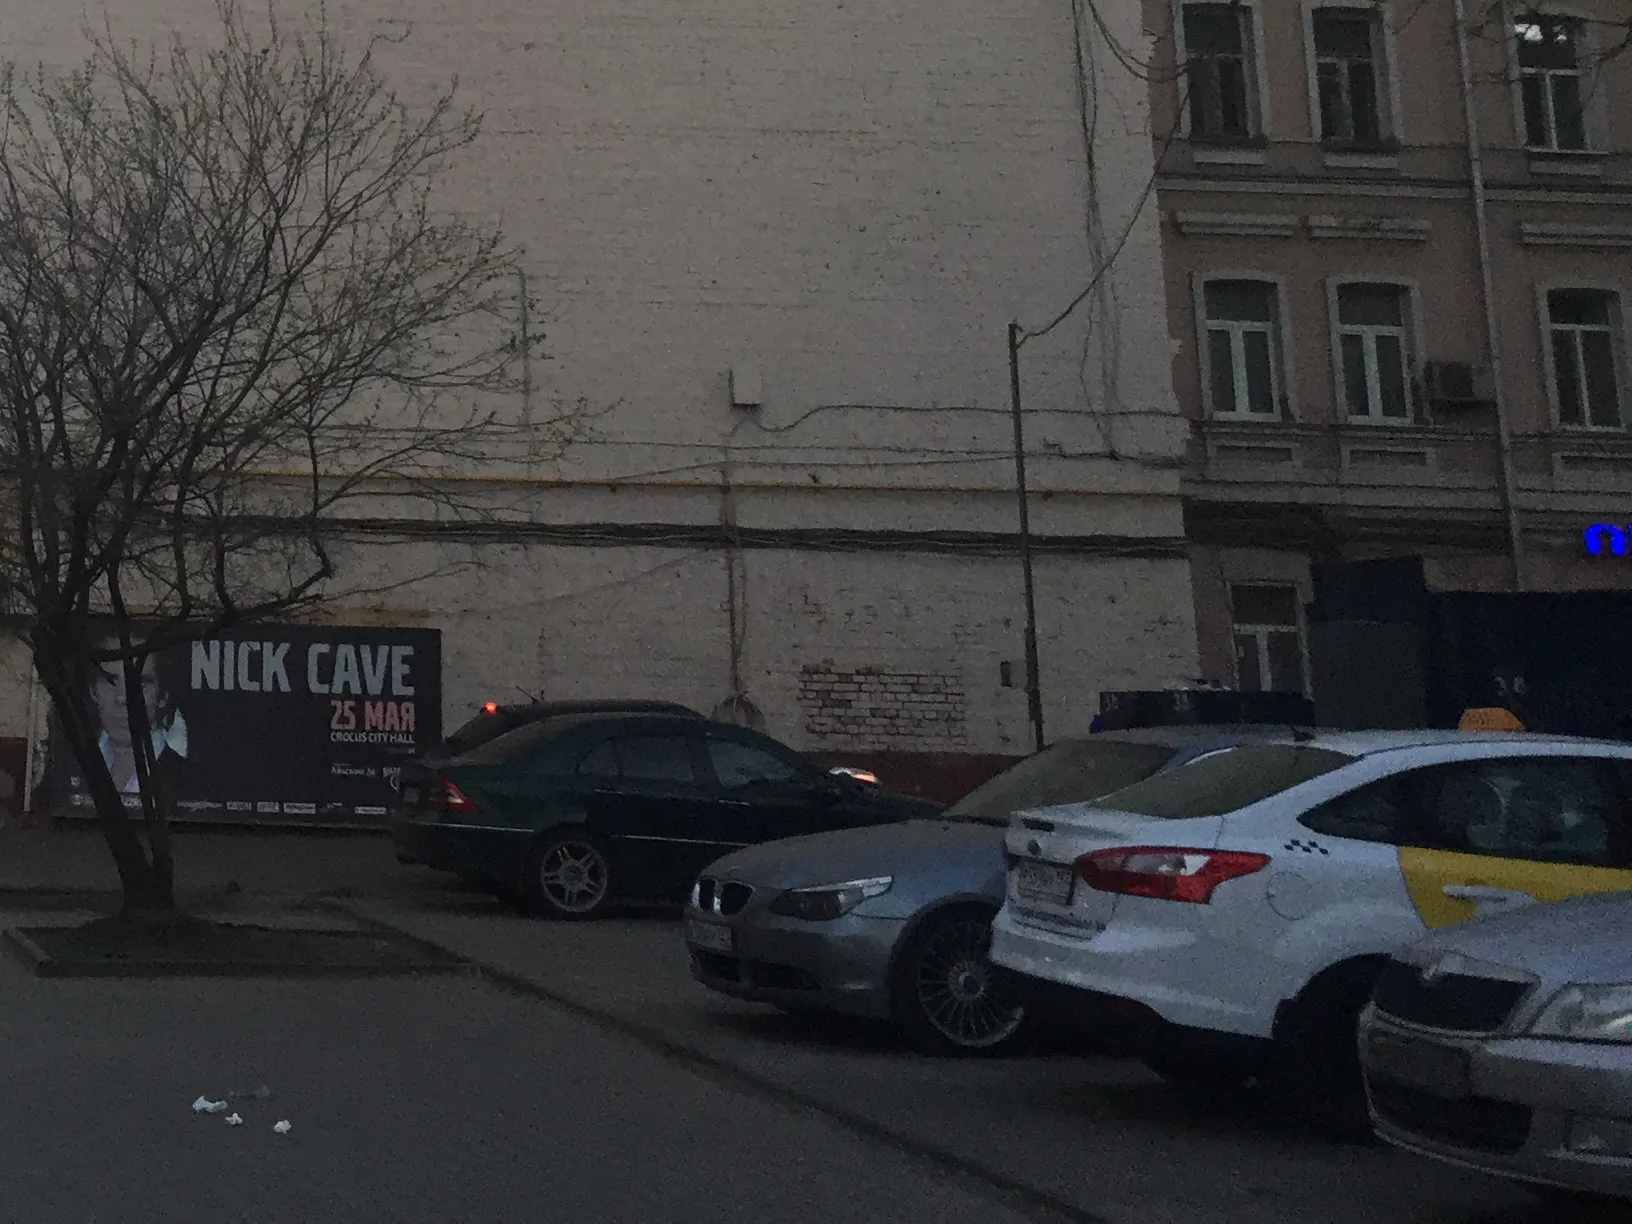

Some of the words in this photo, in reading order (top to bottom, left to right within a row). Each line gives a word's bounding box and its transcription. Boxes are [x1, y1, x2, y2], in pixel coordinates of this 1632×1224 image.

[190, 639, 291, 693] NICK
[307, 642, 416, 696] CAVE
[330, 699, 356, 731] 25
[364, 700, 415, 732] МАЯ
[330, 731, 367, 743] CROCUS
[368, 732, 389, 743] CITY
[389, 733, 415, 744] HALL
